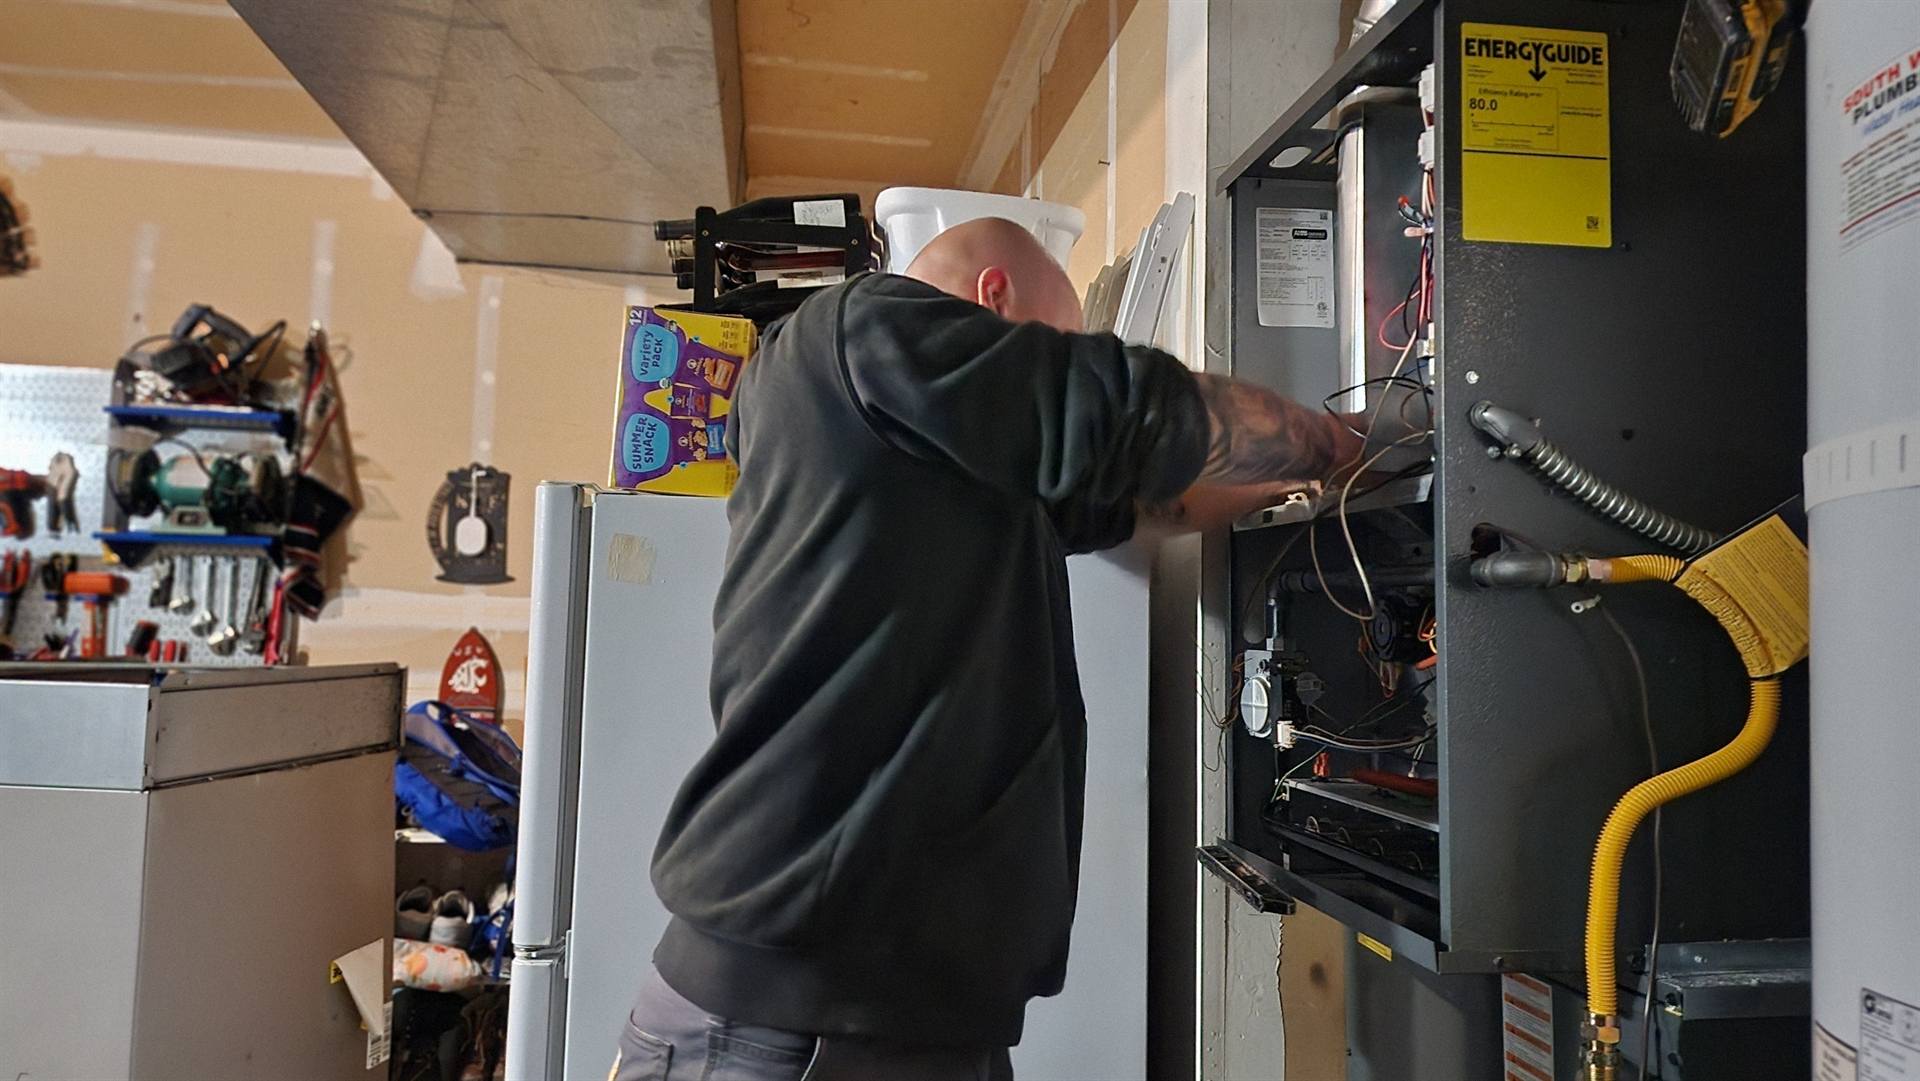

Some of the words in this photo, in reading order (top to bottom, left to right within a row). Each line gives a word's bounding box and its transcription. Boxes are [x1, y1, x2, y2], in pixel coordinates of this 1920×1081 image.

[1465, 37, 1604, 67] ENERGYGUIDE
[1469, 98, 1498, 111] 80.0
[1843, 62, 1902, 114] SOUTH
[629, 309, 643, 326] 12
[632, 416, 648, 469] SUMMER
[643, 422, 657, 463] SNACK
